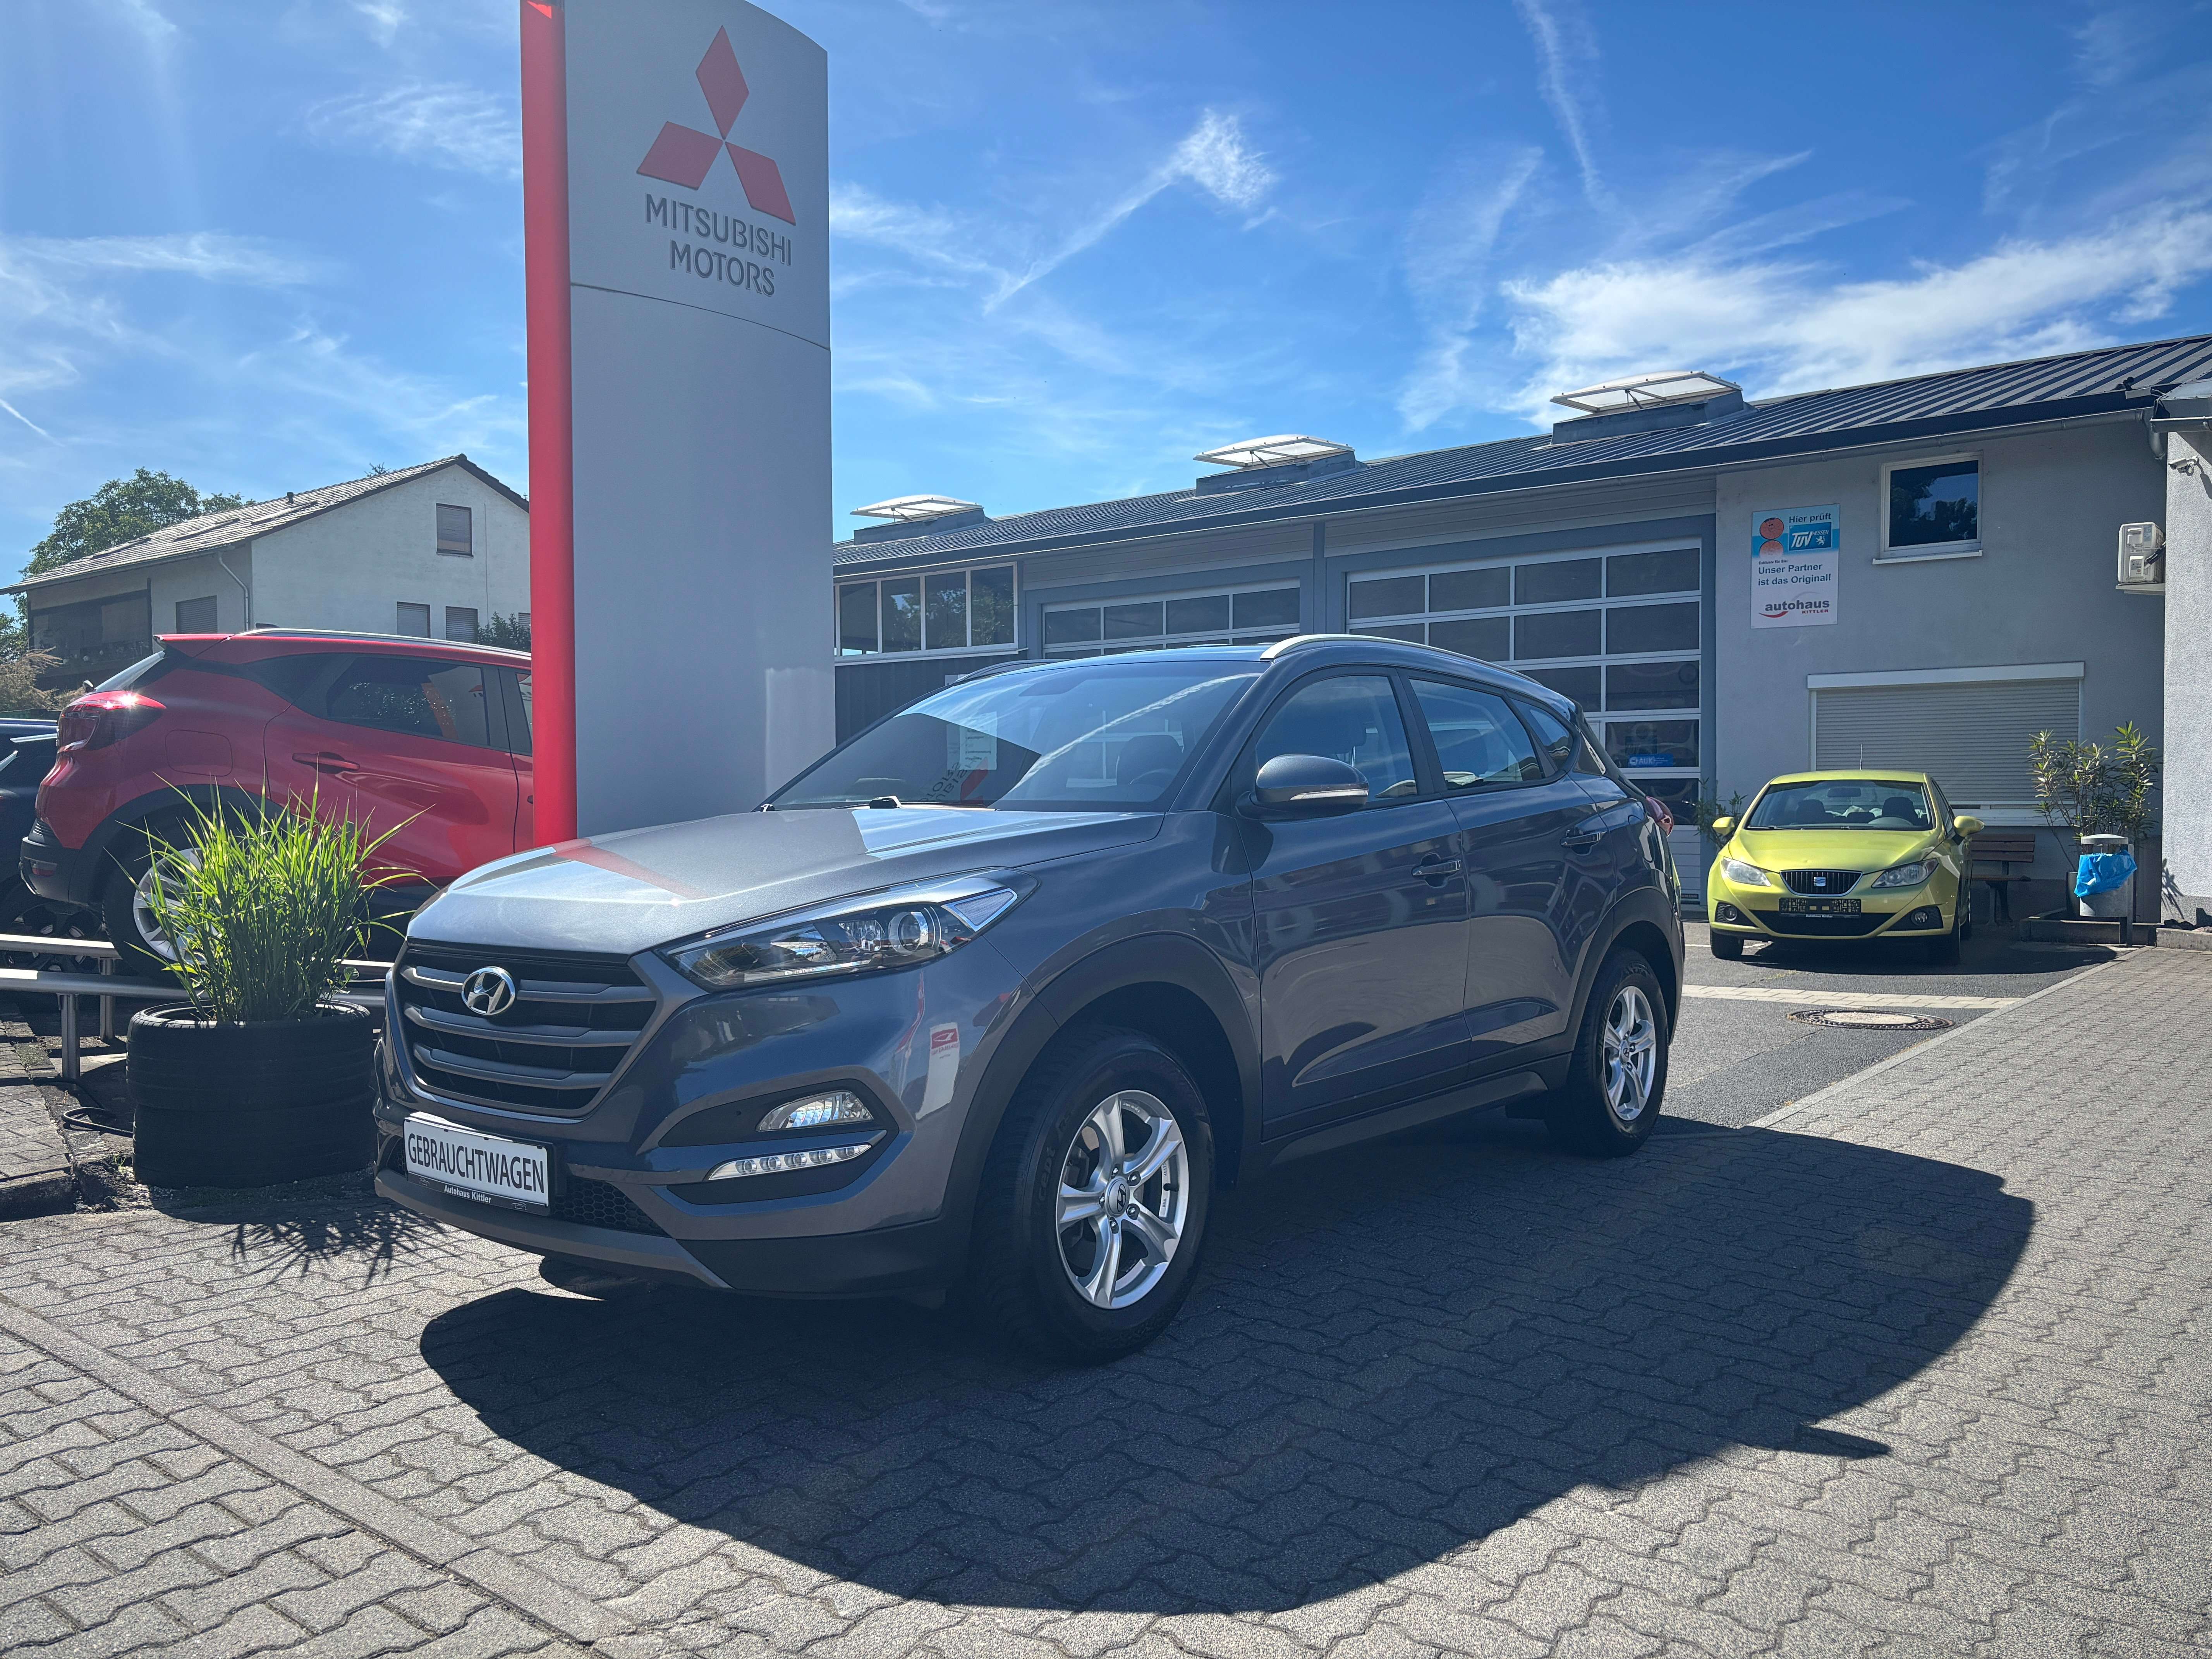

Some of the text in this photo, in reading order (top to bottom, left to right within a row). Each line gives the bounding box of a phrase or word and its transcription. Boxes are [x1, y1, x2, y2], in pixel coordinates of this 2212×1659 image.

[645, 193, 792, 266] MITSUBISHI
[670, 240, 775, 297] MOTORS
[1810, 513, 1831, 522] prüft
[1788, 563, 1822, 572] Partner
[1758, 574, 1831, 586] ist das Original!
[1765, 600, 1830, 611] autohaus
[408, 1133, 544, 1193] GEBRAUCHTWAGEN
[444, 1184, 491, 1203] Autohaus Kittler
